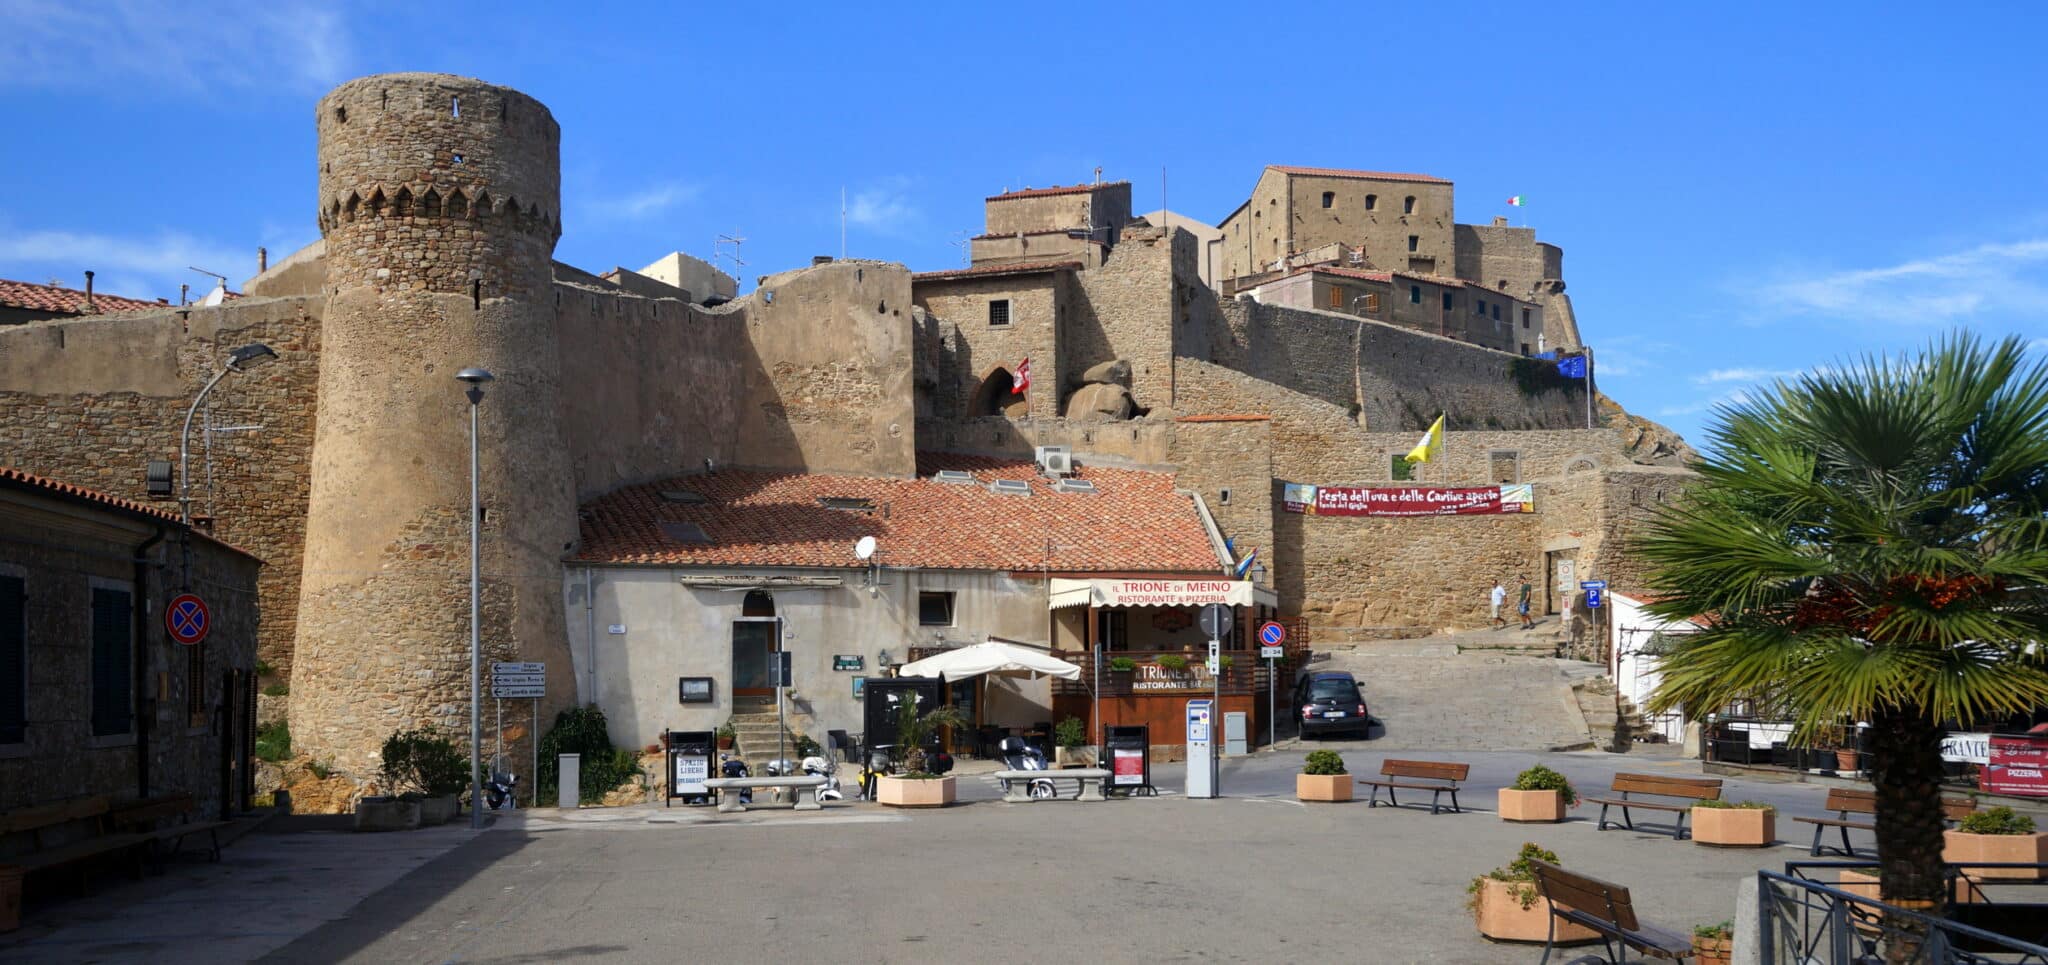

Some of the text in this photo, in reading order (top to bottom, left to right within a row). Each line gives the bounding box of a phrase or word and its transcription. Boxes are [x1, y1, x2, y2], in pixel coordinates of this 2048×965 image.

[1319, 489, 1348, 504] Festa
[1391, 494, 1398, 502] e
[1399, 489, 1424, 502] delle
[1427, 490, 1464, 502] Cantine
[1466, 490, 1499, 503] aperte
[1112, 582, 1231, 593] IL TRIONE DI MEINO
[1118, 594, 1176, 603] RISTORANTE
[1185, 594, 1226, 603] PIZZERIA
[1590, 590, 1597, 599] P
[1133, 681, 1187, 689] RISTORANTE
[2007, 769, 2043, 778] PIZZERIA
